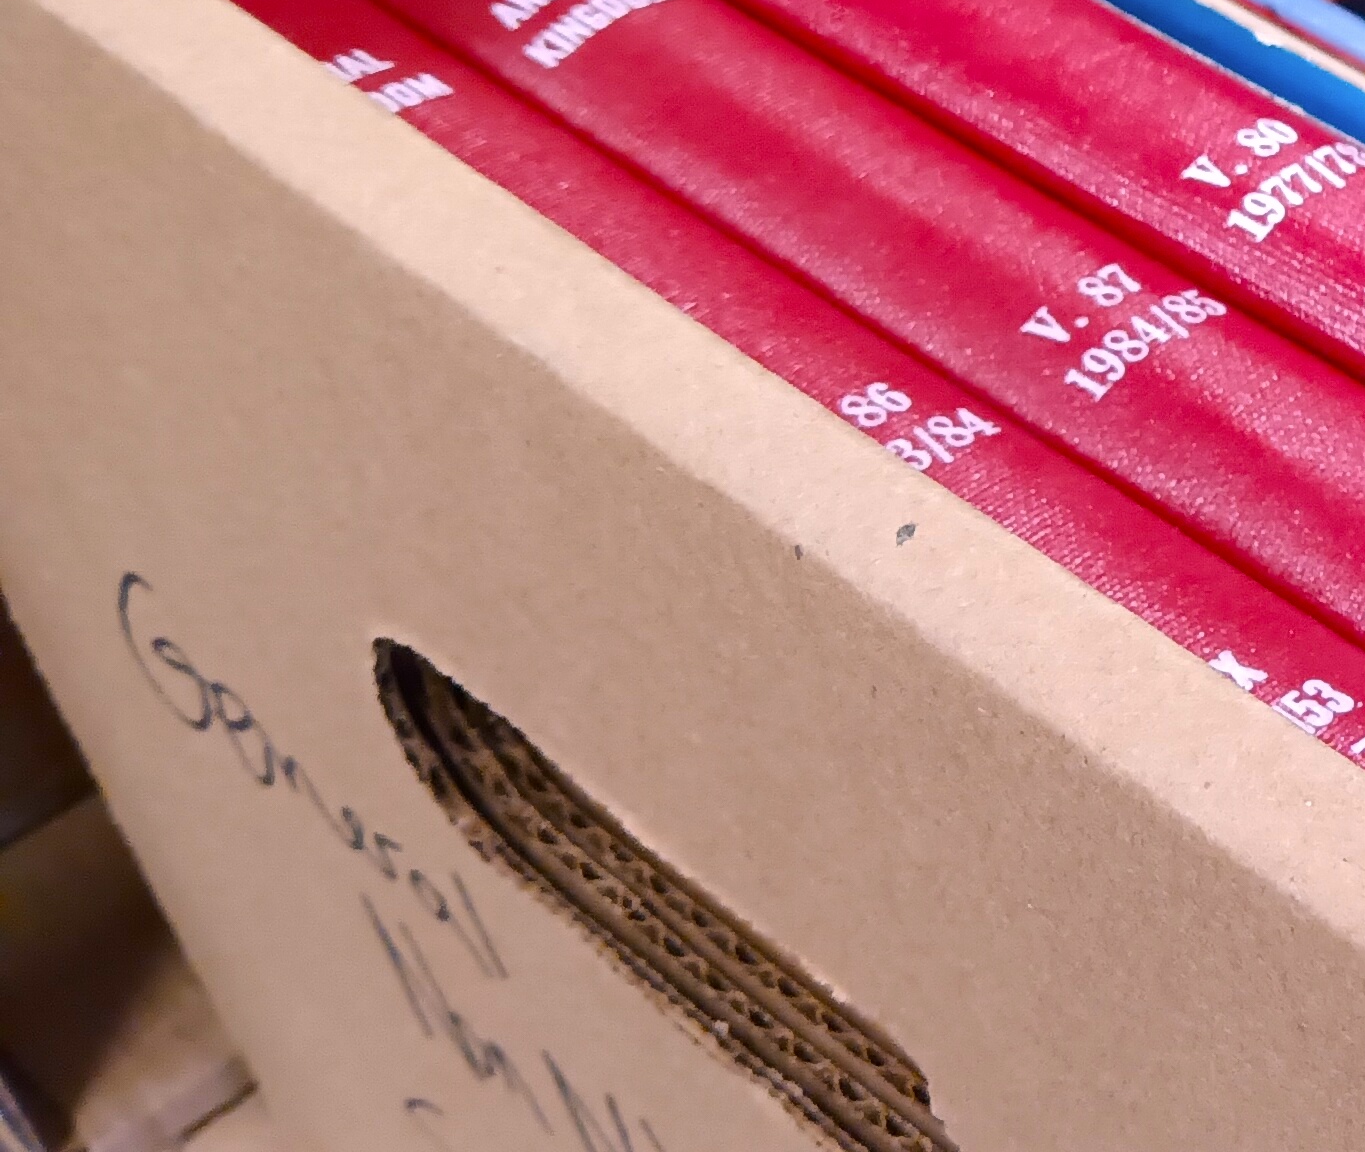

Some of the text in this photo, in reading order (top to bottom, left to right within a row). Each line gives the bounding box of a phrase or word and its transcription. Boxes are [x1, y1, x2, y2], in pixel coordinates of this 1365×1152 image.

[1236, 118, 1299, 158] 80
[1077, 263, 1142, 307] 87
[1063, 289, 1228, 402] 1984/85
[841, 382, 913, 427] 86
[885, 408, 1002, 471] 3/84
[1271, 679, 1356, 735] 53
